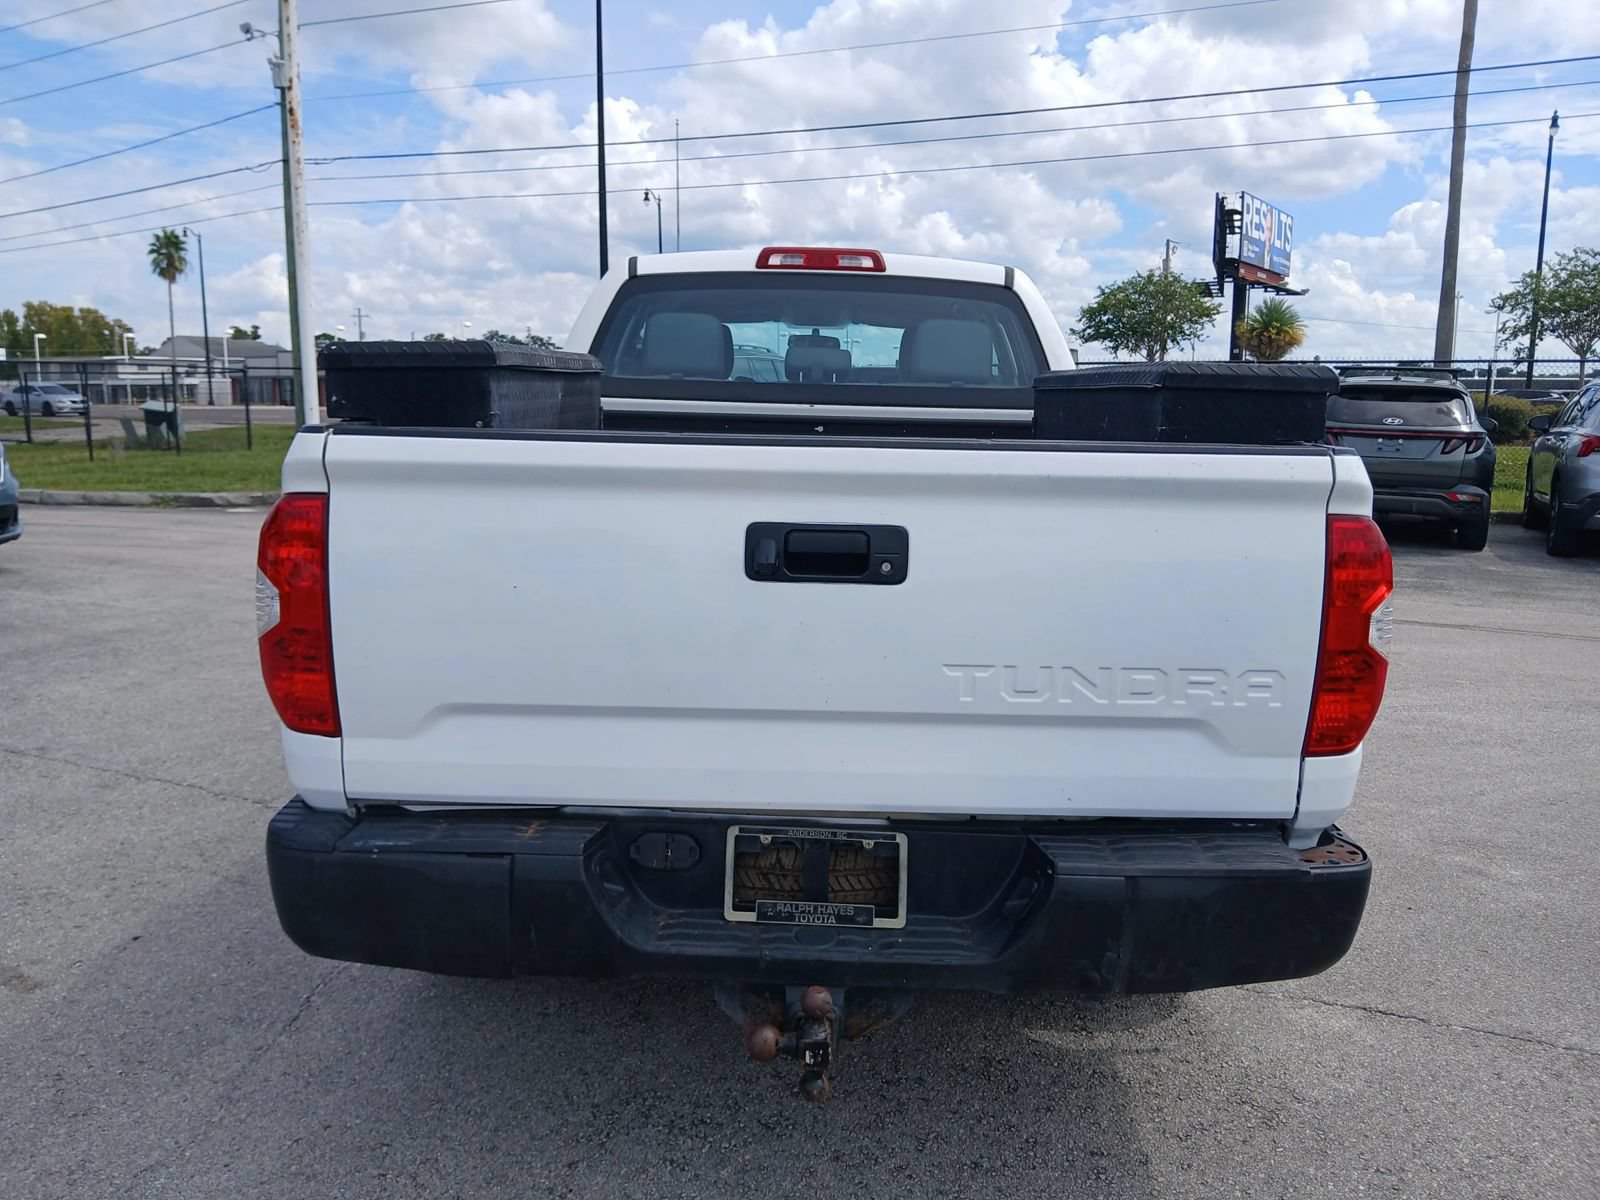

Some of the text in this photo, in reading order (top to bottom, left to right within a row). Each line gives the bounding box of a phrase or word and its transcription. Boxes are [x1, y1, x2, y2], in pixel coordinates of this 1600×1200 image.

[942, 664, 1286, 707] TUNDRA
[776, 903, 855, 917] RALPH HAYES
[794, 913, 836, 924] TOYOTA
